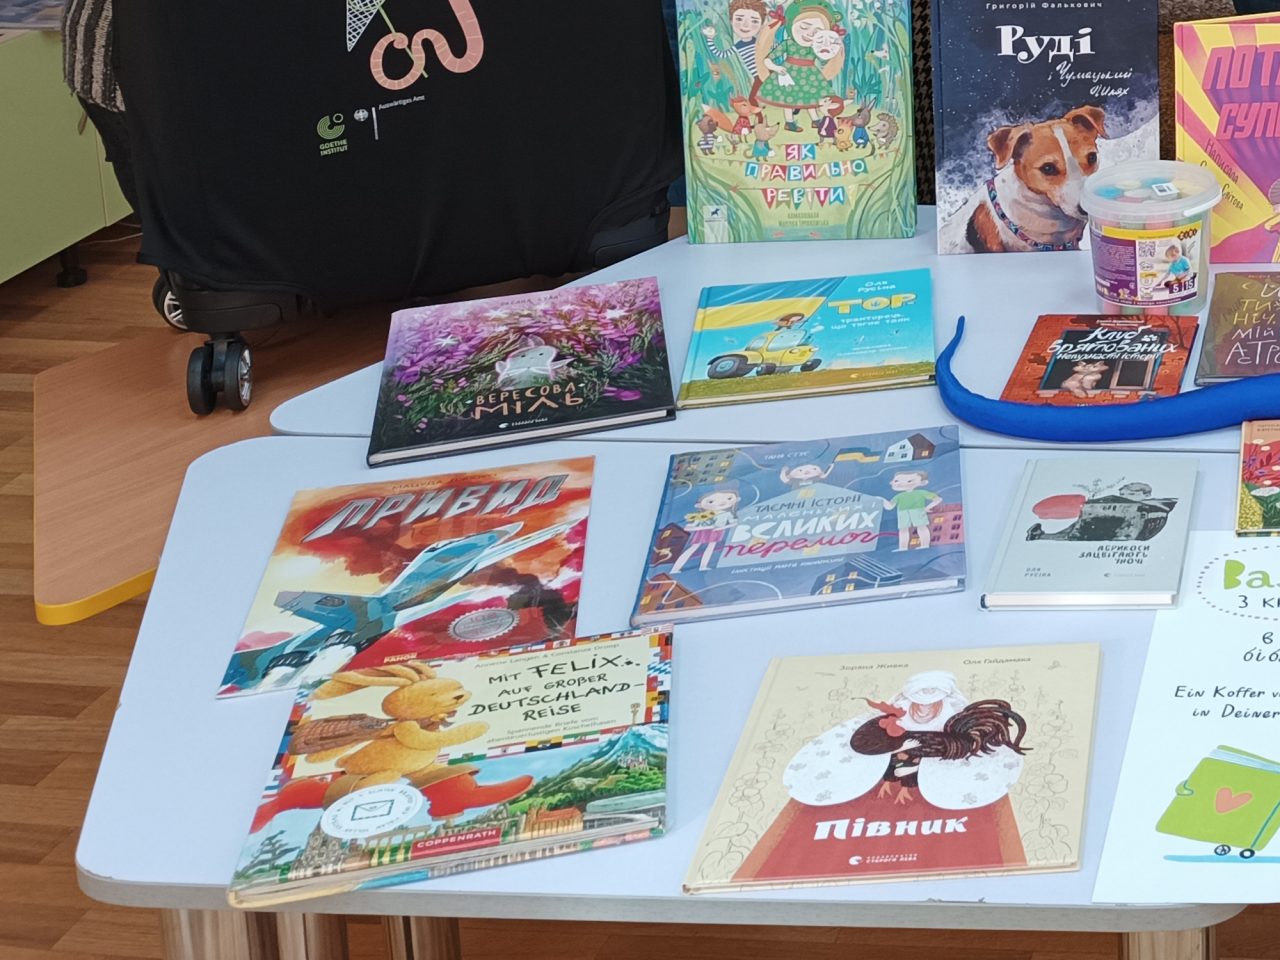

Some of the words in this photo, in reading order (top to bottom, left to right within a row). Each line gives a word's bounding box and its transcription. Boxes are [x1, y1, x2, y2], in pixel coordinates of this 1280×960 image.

[985, 2, 1036, 10] Григорій
[995, 24, 1096, 64] Руді
[1055, 60, 1133, 87] Чумацький
[319, 139, 348, 150] GOETHE
[320, 145, 349, 157] INSTITUT
[787, 144, 815, 160] ЯК
[746, 159, 865, 181] ПРАВИЛЬНО
[1204, 139, 1240, 186] Написала
[1078, 324, 1153, 343] Клуб
[1046, 339, 1179, 355] врятованих
[476, 382, 576, 406] ВЕРЕСОВА
[471, 392, 584, 420] МІЛЬ
[301, 474, 570, 543] ПРИВИД
[1097, 544, 1150, 552] АБРИКОСИ
[1262, 631, 1274, 644] в
[467, 682, 645, 717] DEUTSCHLAND-
[497, 685, 533, 698] AUF
[1174, 685, 1205, 698] Ein
[1212, 685, 1266, 700] Koffer
[1192, 705, 1211, 717] in
[1220, 704, 1280, 720] Deiner
[813, 816, 968, 841] Півник
[417, 828, 497, 849] COPPENRATH
